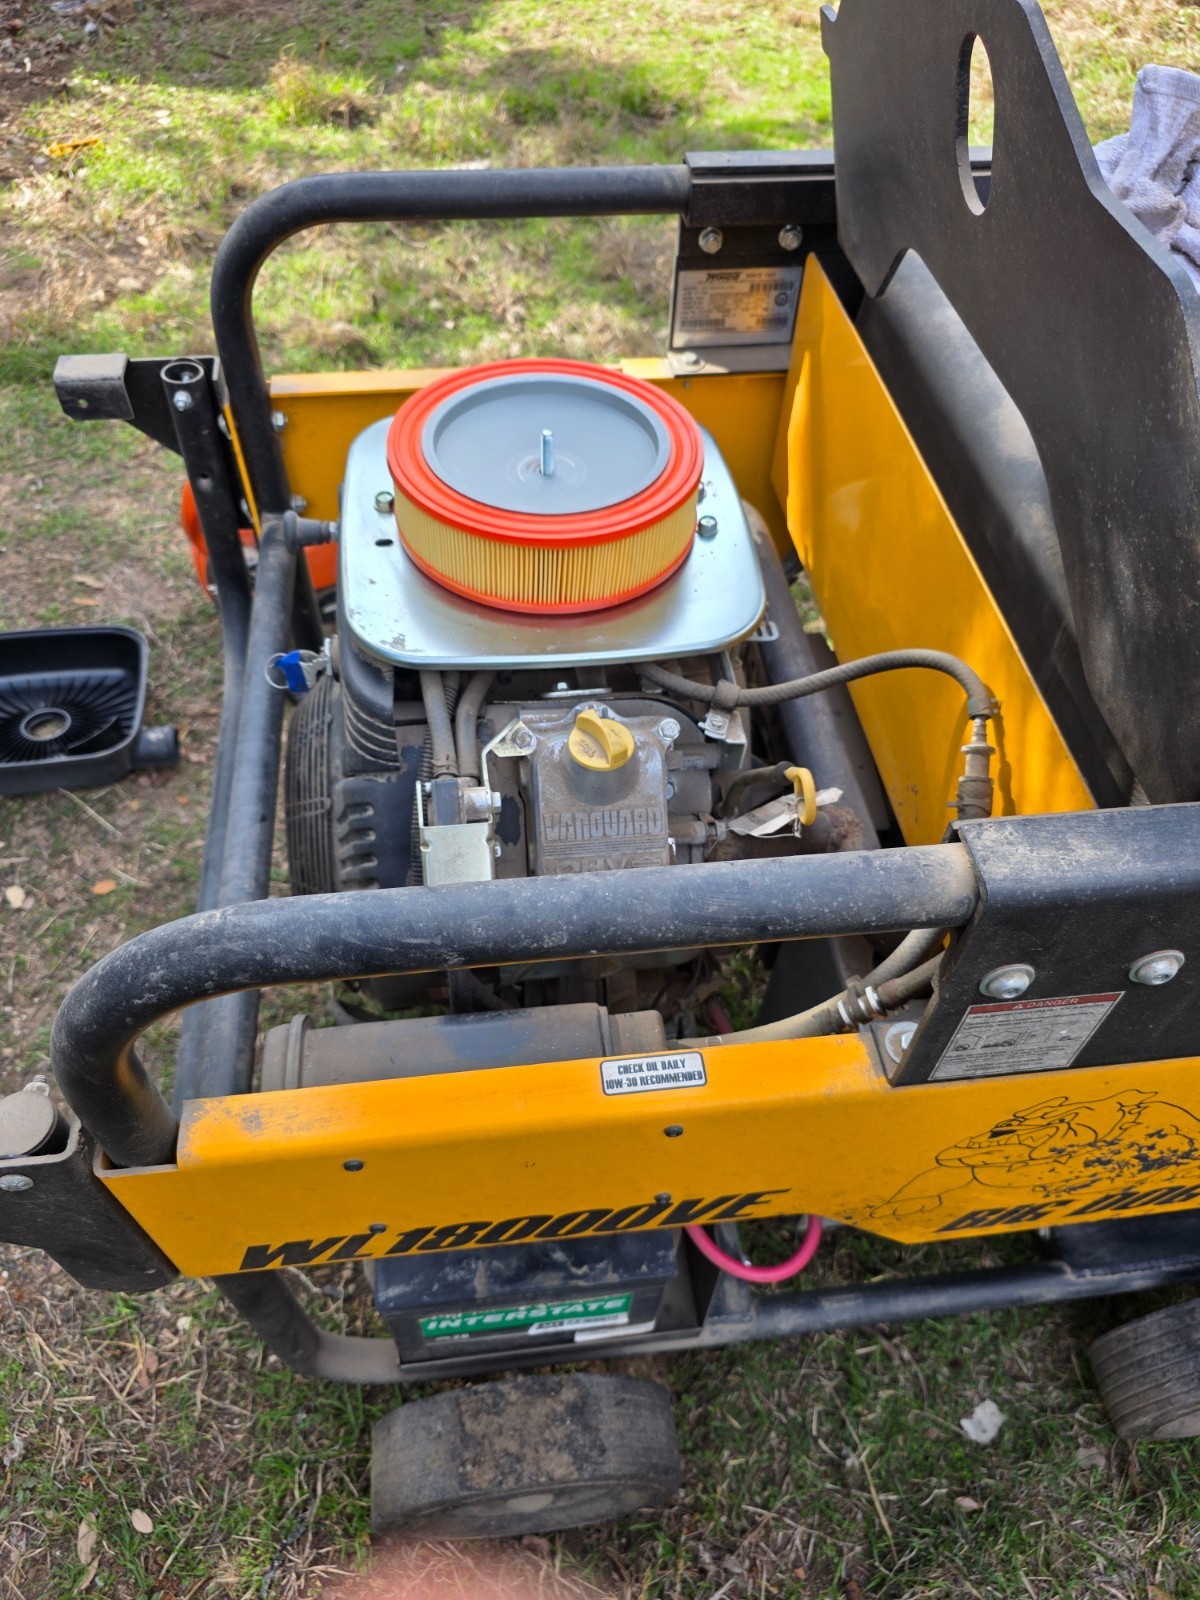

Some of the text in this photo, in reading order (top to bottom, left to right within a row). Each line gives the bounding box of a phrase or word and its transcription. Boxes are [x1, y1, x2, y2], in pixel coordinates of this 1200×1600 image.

[543, 807, 664, 842] VANGUARD
[1026, 998, 1080, 1008] DANGER
[617, 1058, 686, 1075] CHECK OIL DAILY
[605, 1070, 703, 1090] 10W-30 RECOMMENDED
[426, 1297, 627, 1331] INTERSTATE
